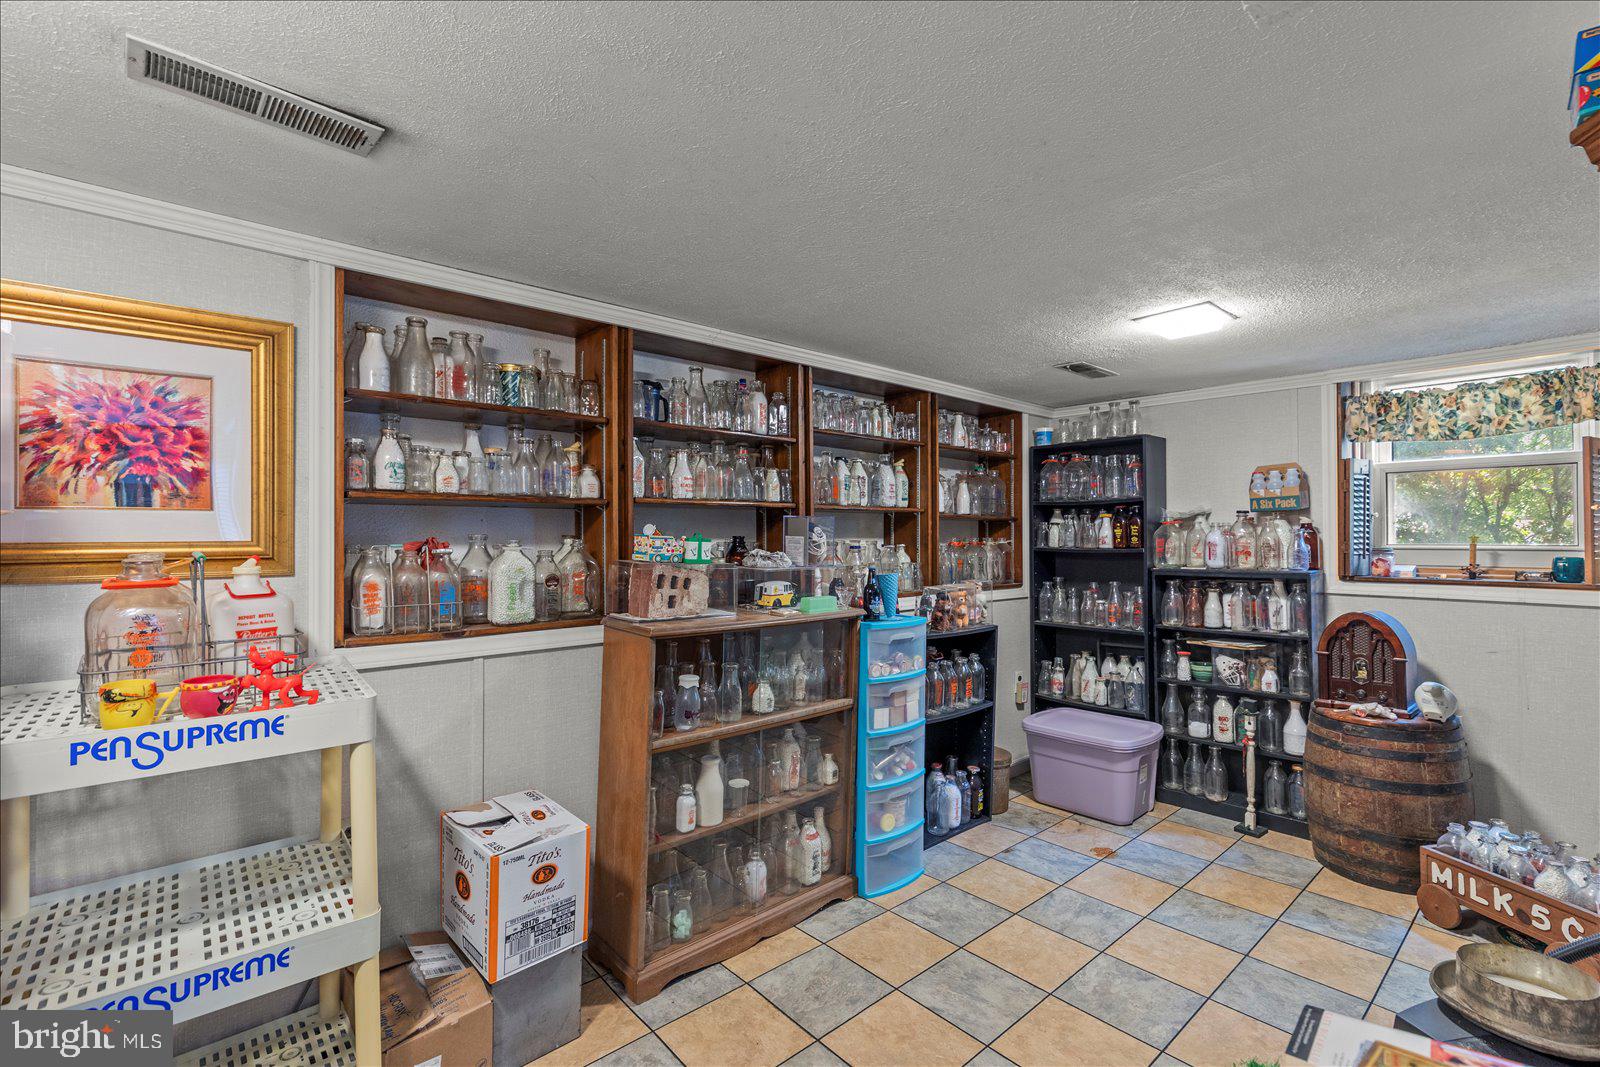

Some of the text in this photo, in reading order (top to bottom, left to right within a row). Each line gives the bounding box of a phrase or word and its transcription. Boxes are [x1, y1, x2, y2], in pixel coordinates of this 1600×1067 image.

[1252, 498, 1297, 509] A Six Pack
[240, 629, 275, 639] Rutter's
[454, 847, 474, 873] Tito's
[528, 846, 562, 867] Tito's
[522, 878, 566, 903] Handmade
[1430, 861, 1515, 917] MILK
